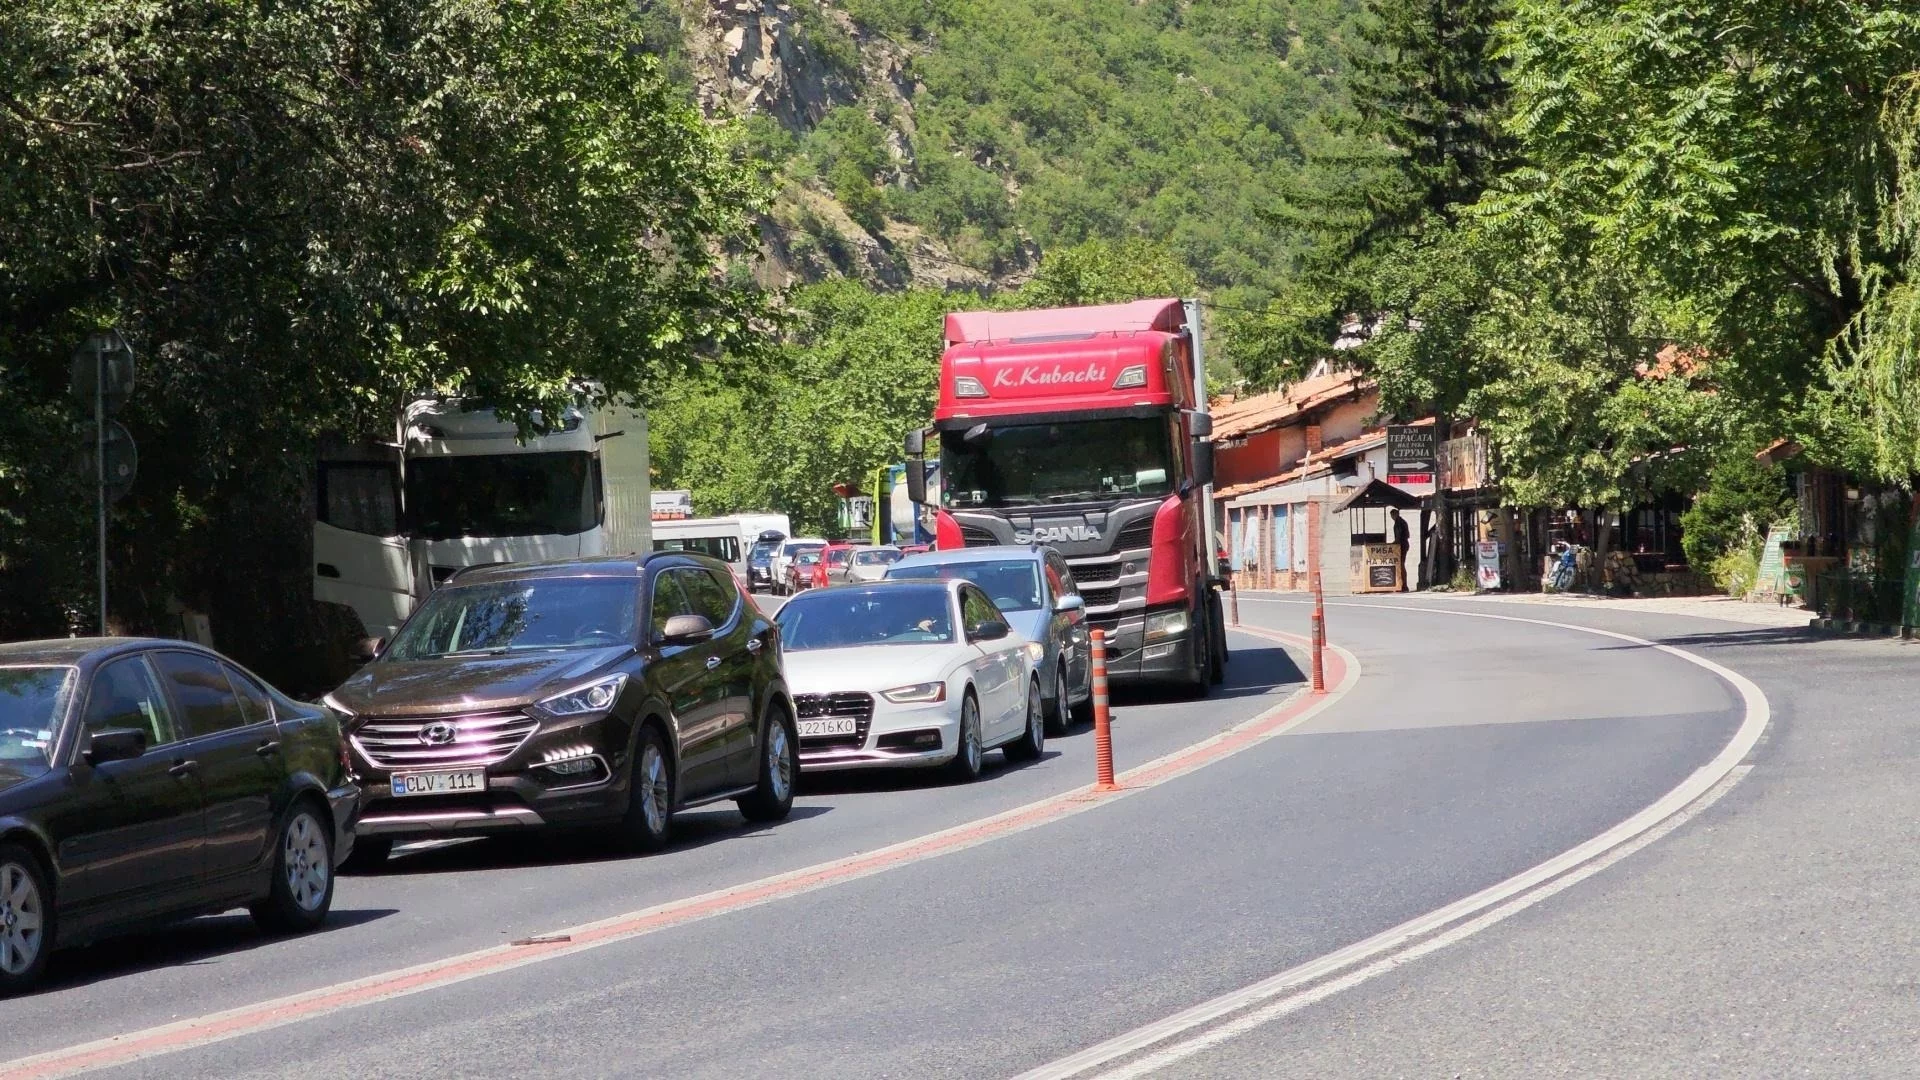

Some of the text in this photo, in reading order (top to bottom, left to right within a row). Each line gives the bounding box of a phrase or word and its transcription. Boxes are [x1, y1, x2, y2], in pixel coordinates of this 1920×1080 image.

[1389, 434, 1433, 442] ТЕРАСАТА
[1393, 449, 1430, 457] СТРУМА
[1014, 526, 1101, 545] SCANIA
[406, 773, 476, 792] CLV 111
